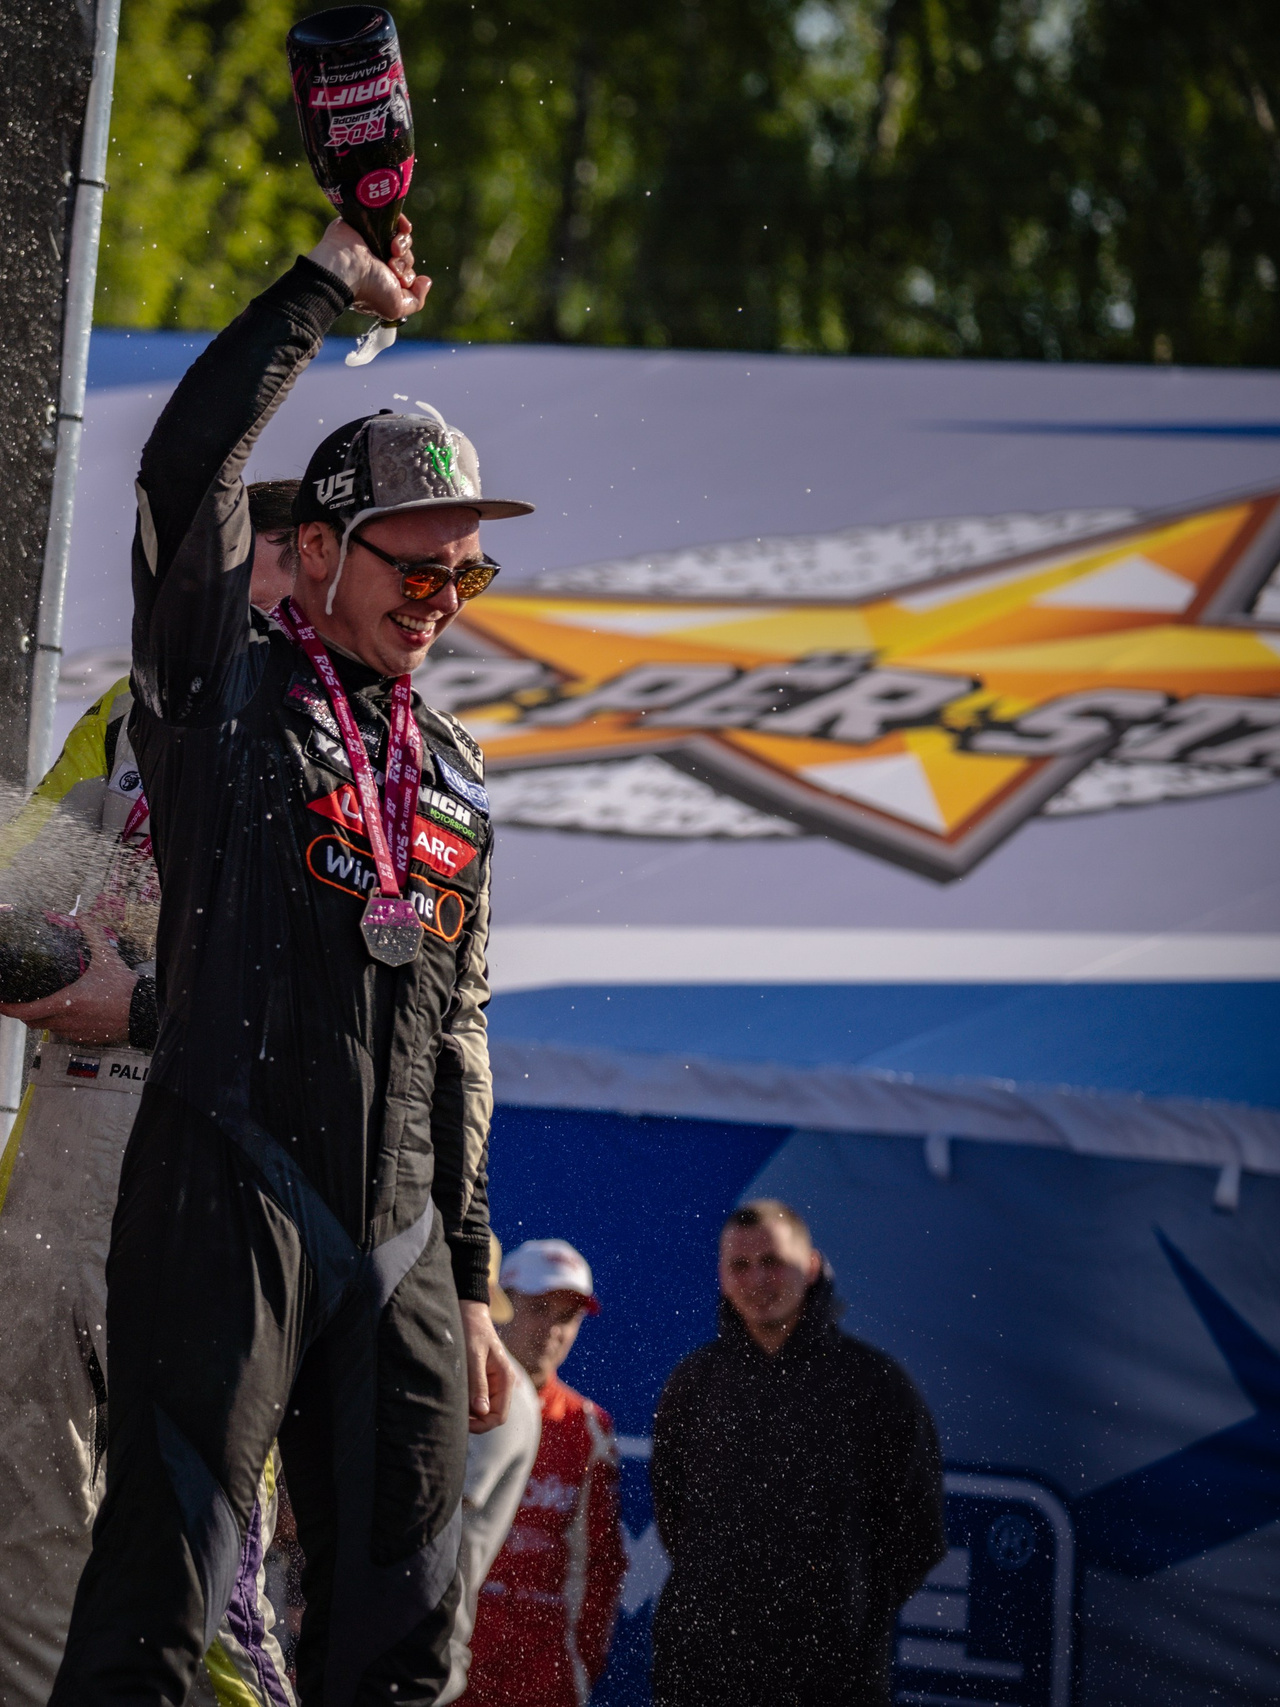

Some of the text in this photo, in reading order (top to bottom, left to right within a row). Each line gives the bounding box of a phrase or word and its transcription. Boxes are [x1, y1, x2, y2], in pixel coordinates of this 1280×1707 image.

[313, 60, 387, 84] CHAMPAGNE
[311, 78, 391, 106] DRIFT
[324, 116, 386, 147] RDS
[333, 113, 370, 125] EUROPE
[368, 179, 390, 191] 24
[368, 187, 391, 199] 20
[314, 654, 341, 687] RDS
[402, 787, 413, 818] EUROPE
[430, 808, 476, 839] MOTORSPORT
[396, 833, 410, 872] RDS
